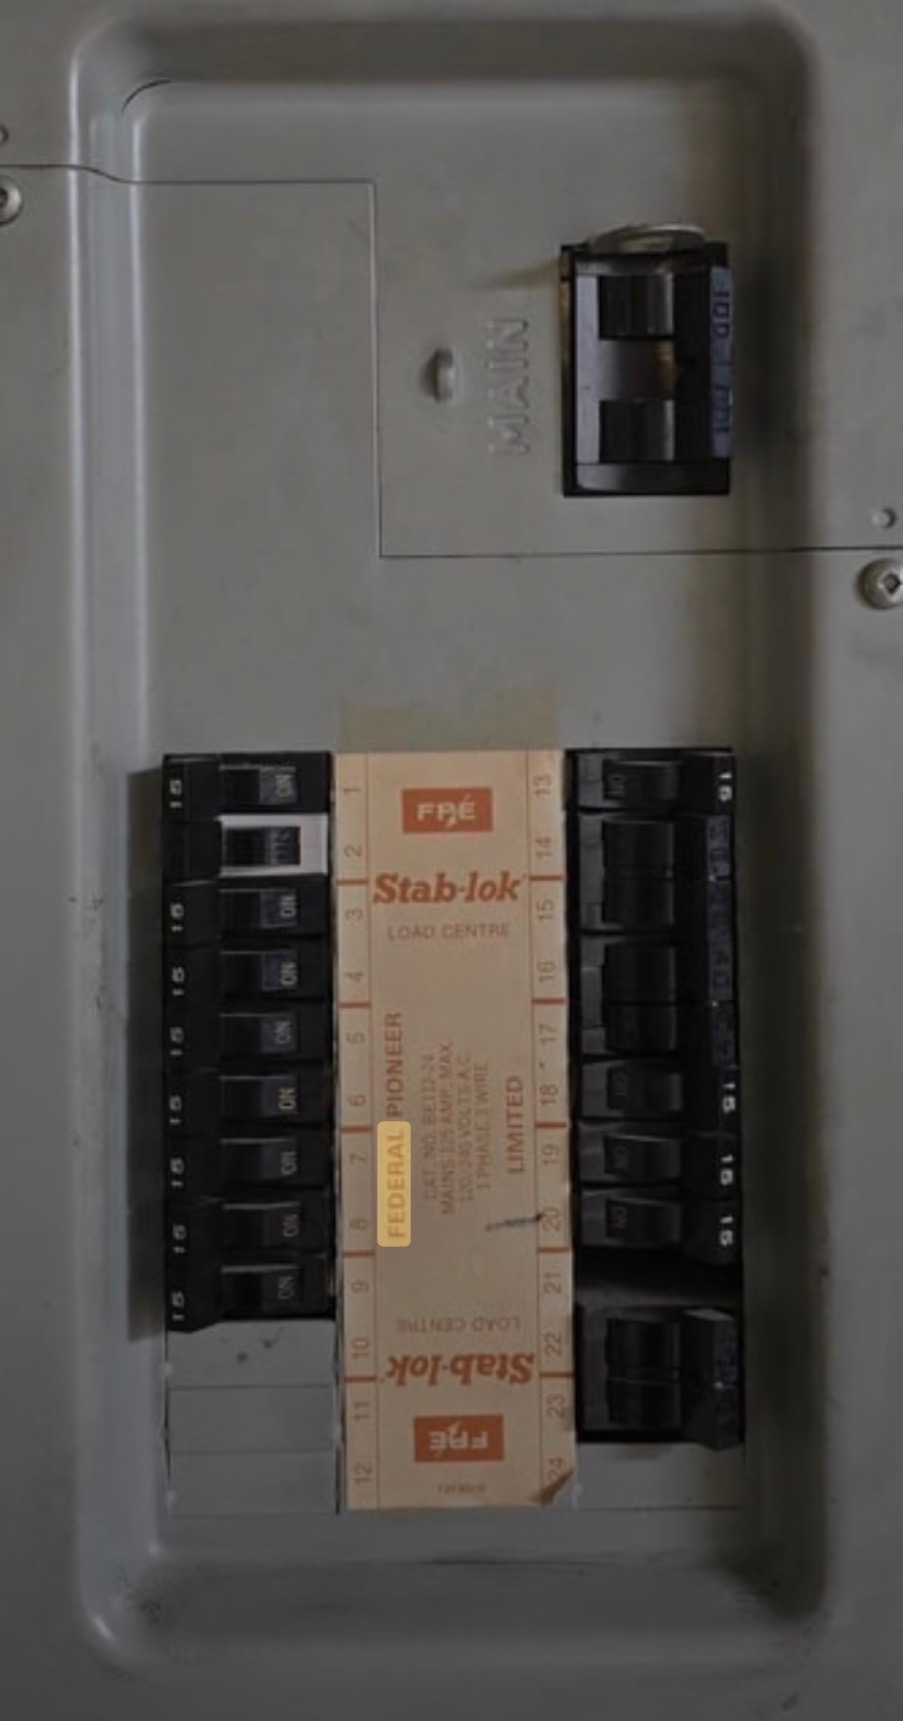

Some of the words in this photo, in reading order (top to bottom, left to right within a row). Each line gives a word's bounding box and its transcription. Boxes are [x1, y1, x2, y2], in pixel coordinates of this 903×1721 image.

[486, 318, 530, 454] MAIN
[169, 779, 183, 809] 15
[275, 773, 294, 797] ON
[343, 786, 360, 794] 1
[535, 774, 552, 797] 13
[718, 771, 733, 802] 15
[344, 845, 362, 858] 2
[535, 837, 552, 858] 14
[169, 901, 185, 934] 15
[279, 894, 297, 919] ON
[344, 908, 363, 921] 3
[536, 900, 554, 922] 15
[387, 924, 434, 941] LOAD
[441, 922, 510, 939] CENTRE
[171, 966, 186, 996] 15
[280, 961, 298, 985] ON
[344, 971, 363, 984] 4
[537, 961, 556, 983] 16
[169, 1026, 185, 1057] 15
[275, 1021, 292, 1044] ON
[346, 1032, 365, 1044] 5
[540, 1023, 558, 1045] 17
[385, 1012, 404, 1117] PIONEER
[474, 1062, 489, 1107] WIRE
[540, 1083, 558, 1106] 18
[169, 1094, 183, 1125] 15
[278, 1087, 297, 1110] ON
[349, 1094, 366, 1106] 6
[722, 1081, 736, 1114] 15
[457, 1086, 472, 1138] VOLTS
[506, 1076, 524, 1174] LIMITED
[350, 1153, 367, 1166] 7
[475, 1121, 490, 1180] PHASE
[541, 1143, 559, 1166] 19
[169, 1156, 185, 1188] 15
[720, 1153, 735, 1186] 15
[387, 1128, 405, 1238] FEDERAL
[438, 1158, 454, 1215] MAINS
[282, 1214, 299, 1238] ON
[351, 1218, 368, 1230] 8
[542, 1207, 561, 1232] 20
[719, 1215, 734, 1247] 15
[172, 1223, 187, 1254] 15
[278, 1276, 295, 1300] ON
[351, 1280, 369, 1293] 9
[544, 1272, 562, 1294] 21
[170, 1291, 185, 1322] 15
[397, 1316, 466, 1334] CENTRE
[472, 1315, 520, 1332] LOAD
[352, 1338, 370, 1359] 10
[544, 1332, 562, 1356] 22
[353, 1402, 370, 1420] 11
[546, 1394, 565, 1418] 23
[354, 1463, 372, 1484] 12
[548, 1457, 567, 1481] 24
